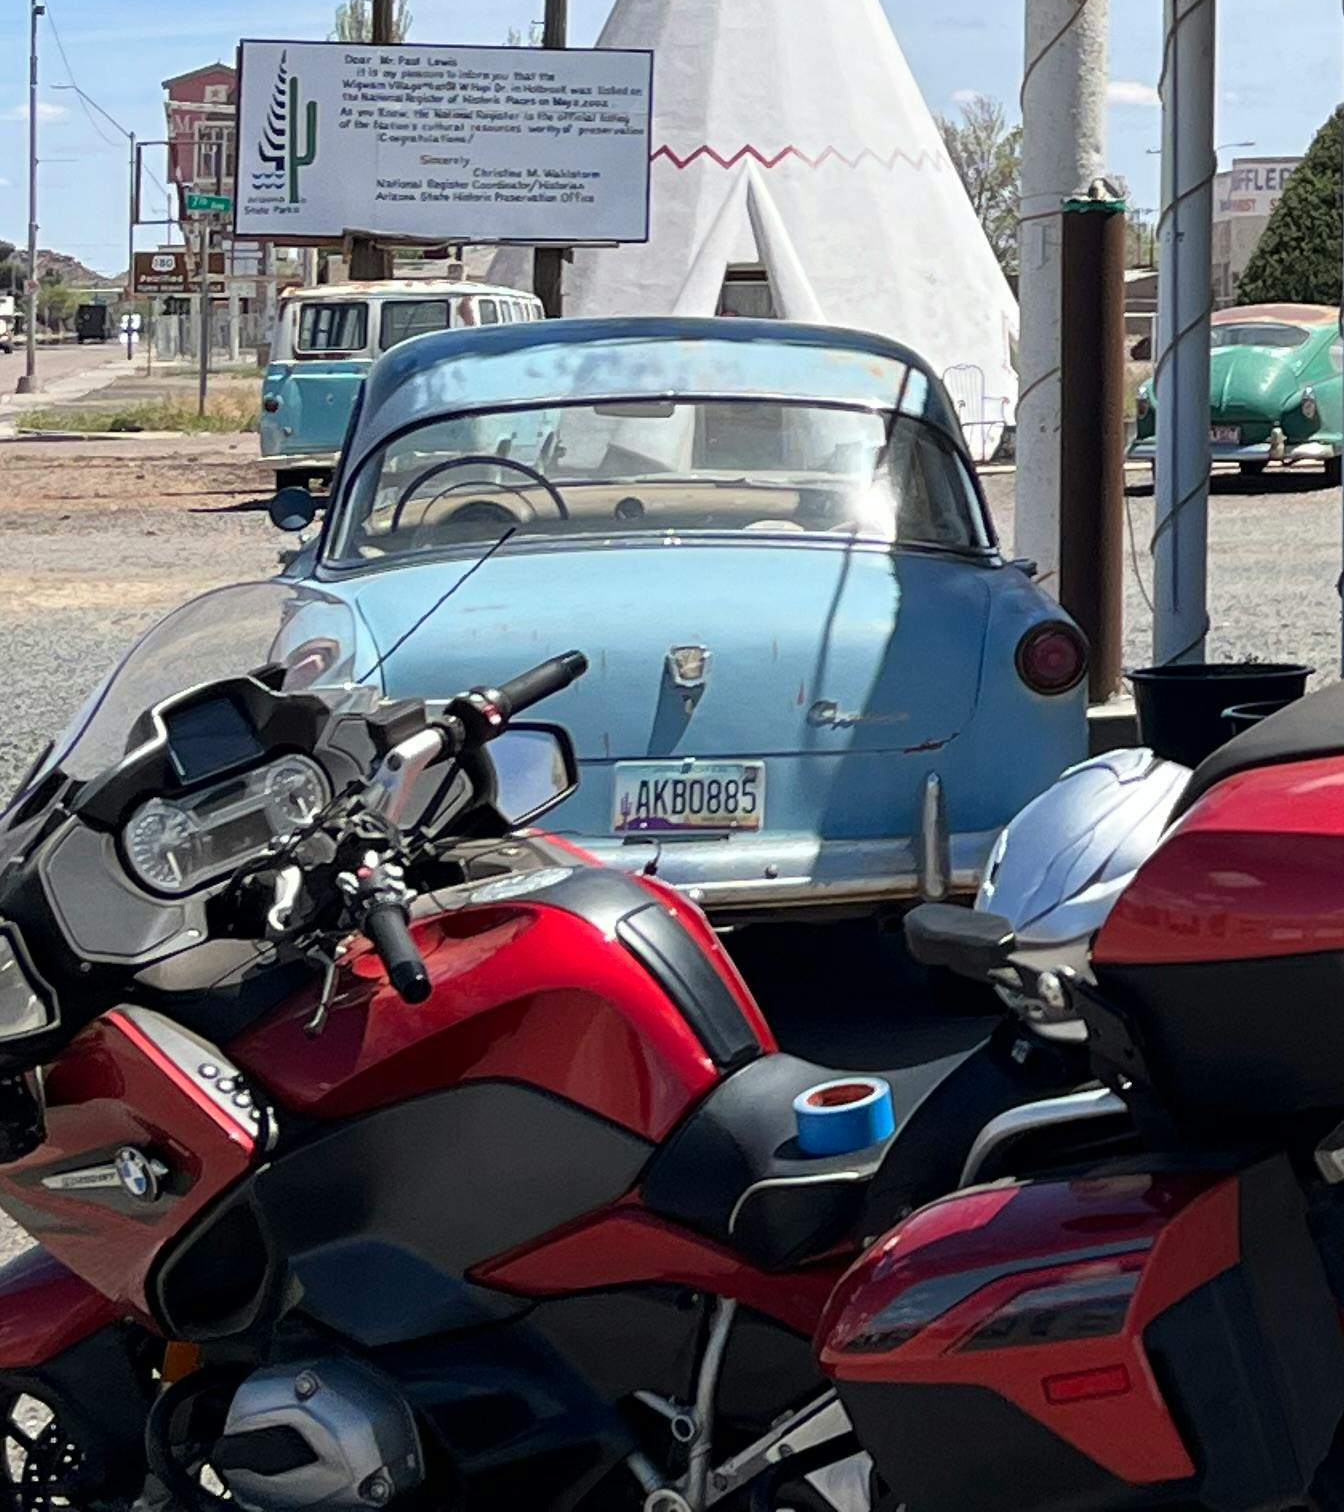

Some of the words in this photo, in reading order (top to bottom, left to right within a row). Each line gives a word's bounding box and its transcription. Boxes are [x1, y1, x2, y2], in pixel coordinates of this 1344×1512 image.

[344, 54, 372, 65] Dear
[398, 56, 421, 66] Paul
[427, 57, 458, 67] Lewis
[491, 72, 509, 82] you
[514, 71, 536, 81] that
[539, 72, 555, 82] the
[342, 79, 386, 92] Wigwam
[570, 87, 593, 95] was
[598, 85, 628, 95] listed
[361, 93, 403, 103] National
[405, 94, 444, 105] Register
[448, 94, 460, 103] of
[552, 97, 572, 109] May
[339, 107, 353, 116] As
[434, 109, 473, 119] National
[537, 112, 554, 122] the
[557, 112, 596, 122] official
[339, 119, 351, 129] of
[354, 120, 370, 129] the
[422, 122, 465, 131] cultural
[470, 123, 522, 134] resources
[528, 124, 561, 137] worthy
[473, 167, 522, 178] Christine
[376, 178, 423, 189] National
[426, 178, 469, 191] Register
[375, 191, 416, 201] Arizona
[420, 191, 450, 202] State
[453, 191, 492, 202] Historic
[494, 191, 557, 203] Preservation
[560, 191, 595, 203] Office
[635, 778, 757, 816] AKB0885
